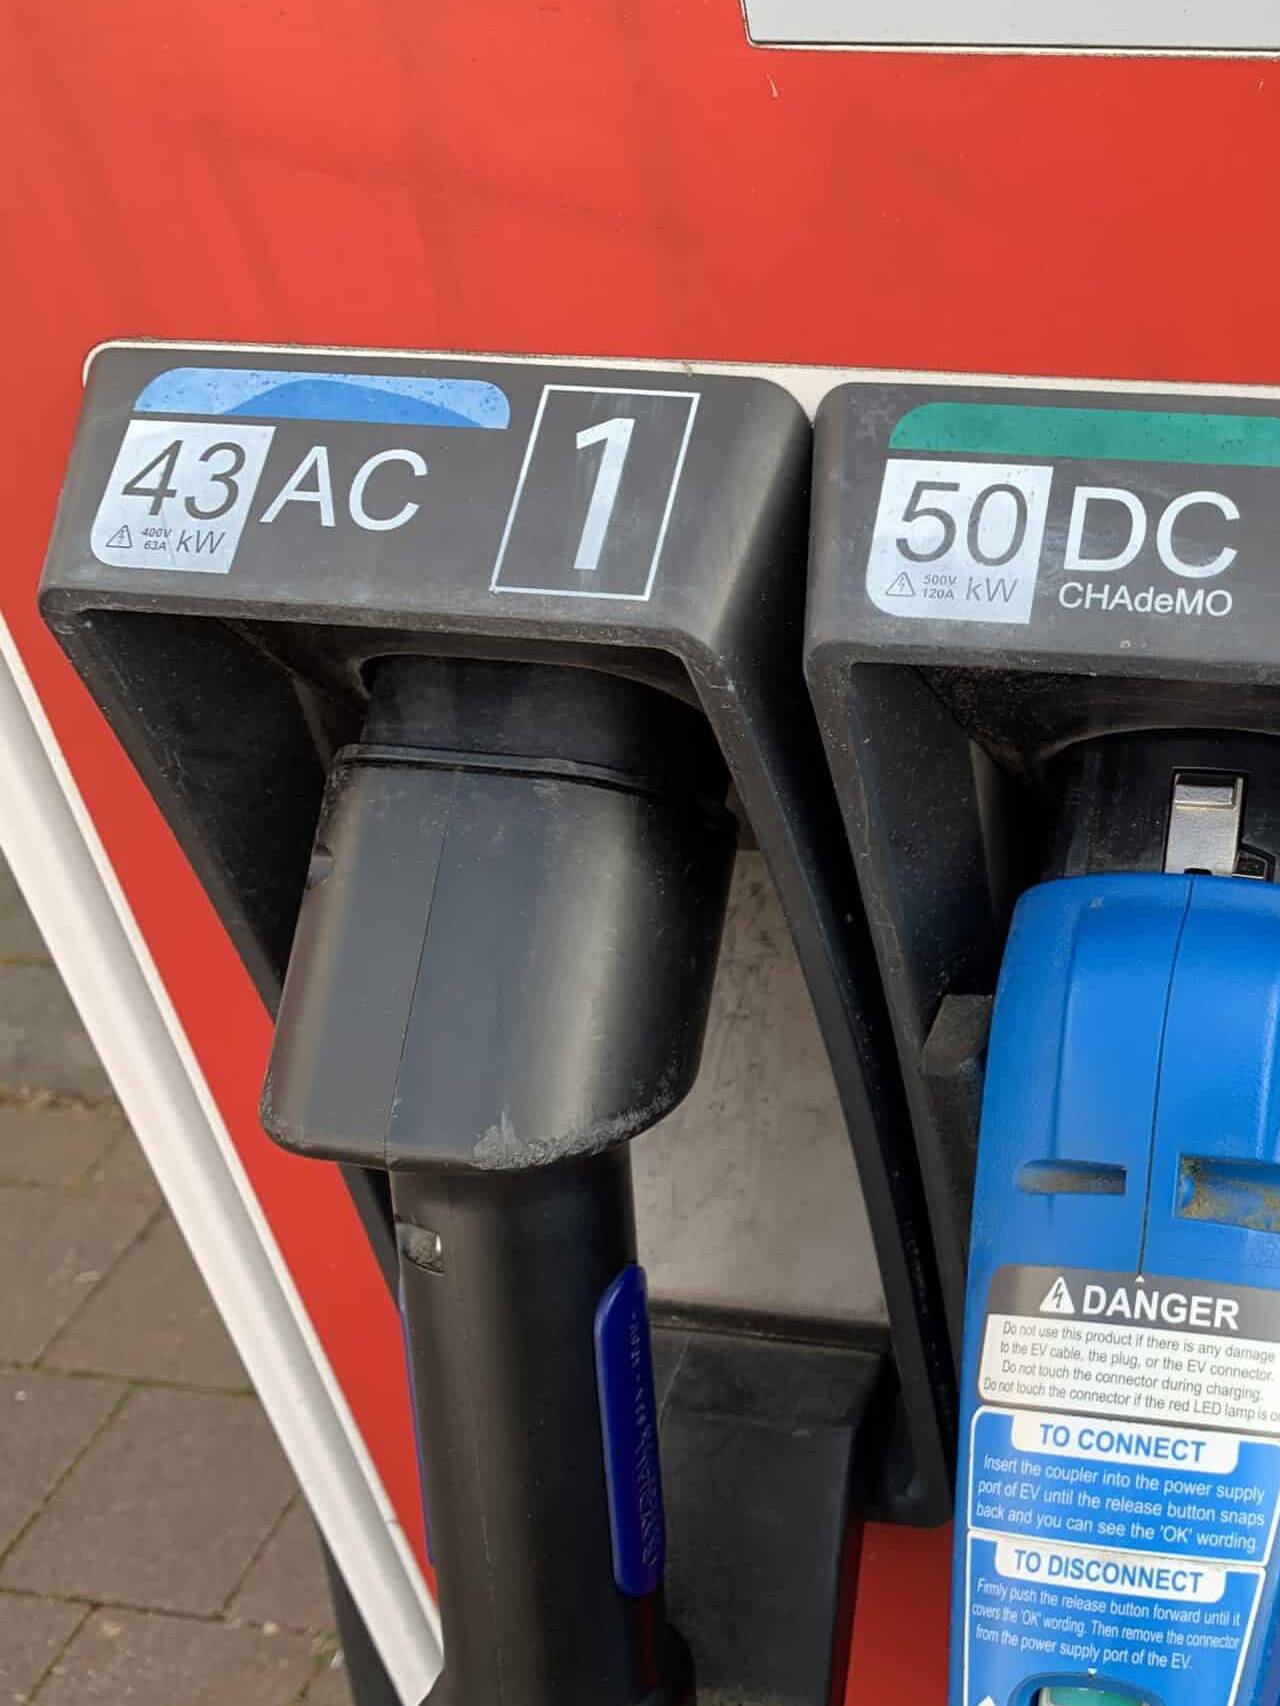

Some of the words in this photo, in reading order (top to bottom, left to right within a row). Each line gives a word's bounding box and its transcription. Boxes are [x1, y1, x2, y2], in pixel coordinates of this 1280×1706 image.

[122, 440, 247, 519] 43
[260, 445, 428, 531] AC
[573, 418, 636, 570] 1
[142, 528, 172, 538] 400V
[144, 541, 166, 551] 63A
[176, 529, 226, 553] kW
[896, 482, 1028, 566] 50
[1062, 486, 1241, 578] DC
[923, 574, 957, 585] 500V
[923, 588, 954, 599] 120A
[966, 577, 1018, 602] kW
[1059, 582, 1234, 618] CHAdeMO
[1083, 1285, 1239, 1330] DANGER
[1001, 1341, 1010, 1353] to
[1012, 1342, 1028, 1355] the
[1031, 1343, 1048, 1355] EV
[1088, 1350, 1107, 1362] the
[1145, 1358, 1160, 1367] or
[1163, 1357, 1183, 1371] the
[1187, 1359, 1207, 1373] EV
[1210, 1366, 1274, 1381] connector.
[1003, 1321, 1016, 1335] Do
[1019, 1324, 1036, 1336] not
[1039, 1328, 1058, 1338] use
[1062, 1328, 1082, 1340] this
[1086, 1331, 1131, 1346] product
[1136, 1334, 1144, 1347] if
[1147, 1336, 1179, 1350] there
[1183, 1341, 1194, 1352] is
[1198, 1343, 1222, 1358] any
[1225, 1345, 1275, 1363] damage
[984, 1377, 997, 1391] Do
[1000, 1381, 1014, 1392] not
[1017, 1383, 1045, 1396] touch
[1049, 1385, 1066, 1398] the
[1070, 1389, 1131, 1406] connector
[1134, 1394, 1143, 1406] if
[1145, 1395, 1165, 1409] the
[1168, 1399, 1190, 1412] red
[1194, 1400, 1221, 1415] LED
[1225, 1403, 1255, 1422] lamp
[1257, 1409, 1267, 1420] is
[1002, 1360, 1016, 1373] Do
[1019, 1363, 1036, 1375] not
[1039, 1365, 1069, 1379] touch
[1073, 1368, 1091, 1381] the
[1096, 1372, 1159, 1388] connector
[1162, 1377, 1202, 1396] during
[1206, 1382, 1263, 1402] charging.
[1040, 1423, 1070, 1447] TO
[1078, 1428, 1206, 1462] CONNECT
[984, 1454, 1017, 1470] Insert
[1021, 1459, 1041, 1477] the
[1045, 1466, 1098, 1484] coupler
[1103, 1470, 1130, 1488] into
[1135, 1473, 1160, 1491] the
[1163, 1480, 1213, 1497] power
[1216, 1484, 1265, 1506] supply
[976, 1502, 1005, 1519] back
[1008, 1509, 1033, 1523] and
[1035, 1514, 1062, 1529] you
[1066, 1517, 1093, 1532] can
[1098, 1523, 1125, 1536] see
[1131, 1521, 1155, 1540] the
[1160, 1524, 1193, 1544] 'OK'
[978, 1479, 1001, 1496] port
[1005, 1483, 1017, 1497] of
[1020, 1483, 1040, 1501] EV
[1044, 1489, 1073, 1505] until
[1078, 1491, 1100, 1509] the
[1105, 1498, 1162, 1516] release
[1167, 1501, 1215, 1521] button
[1220, 1509, 1265, 1529] snaps
[1014, 1549, 1041, 1573] TO
[1048, 1555, 1204, 1593] DISCONNECT
[977, 1578, 1009, 1600] Firmly
[1009, 1586, 1036, 1603] push
[1040, 1591, 1058, 1606] the
[1061, 1595, 1106, 1613] release
[1110, 1601, 1149, 1619] button
[1153, 1604, 1200, 1623] forward
[1204, 1611, 1230, 1626] until
[1233, 1613, 1240, 1627] it
[972, 1603, 1000, 1619] covers
[1003, 1607, 1017, 1623] the
[1043, 1616, 1088, 1638] wording.
[1091, 1619, 1119, 1638] Then
[1121, 1629, 1164, 1644] remove
[1167, 1631, 1184, 1645] the
[1186, 1633, 1240, 1649] connector
[976, 1624, 999, 1641] from
[1001, 1630, 1018, 1646] the
[1021, 1636, 1057, 1652] power
[1059, 1643, 1100, 1663] supply
[1103, 1649, 1128, 1663] port
[1131, 1650, 1144, 1664] of
[1147, 1651, 1168, 1667] the
[1171, 1653, 1192, 1670] EV.
